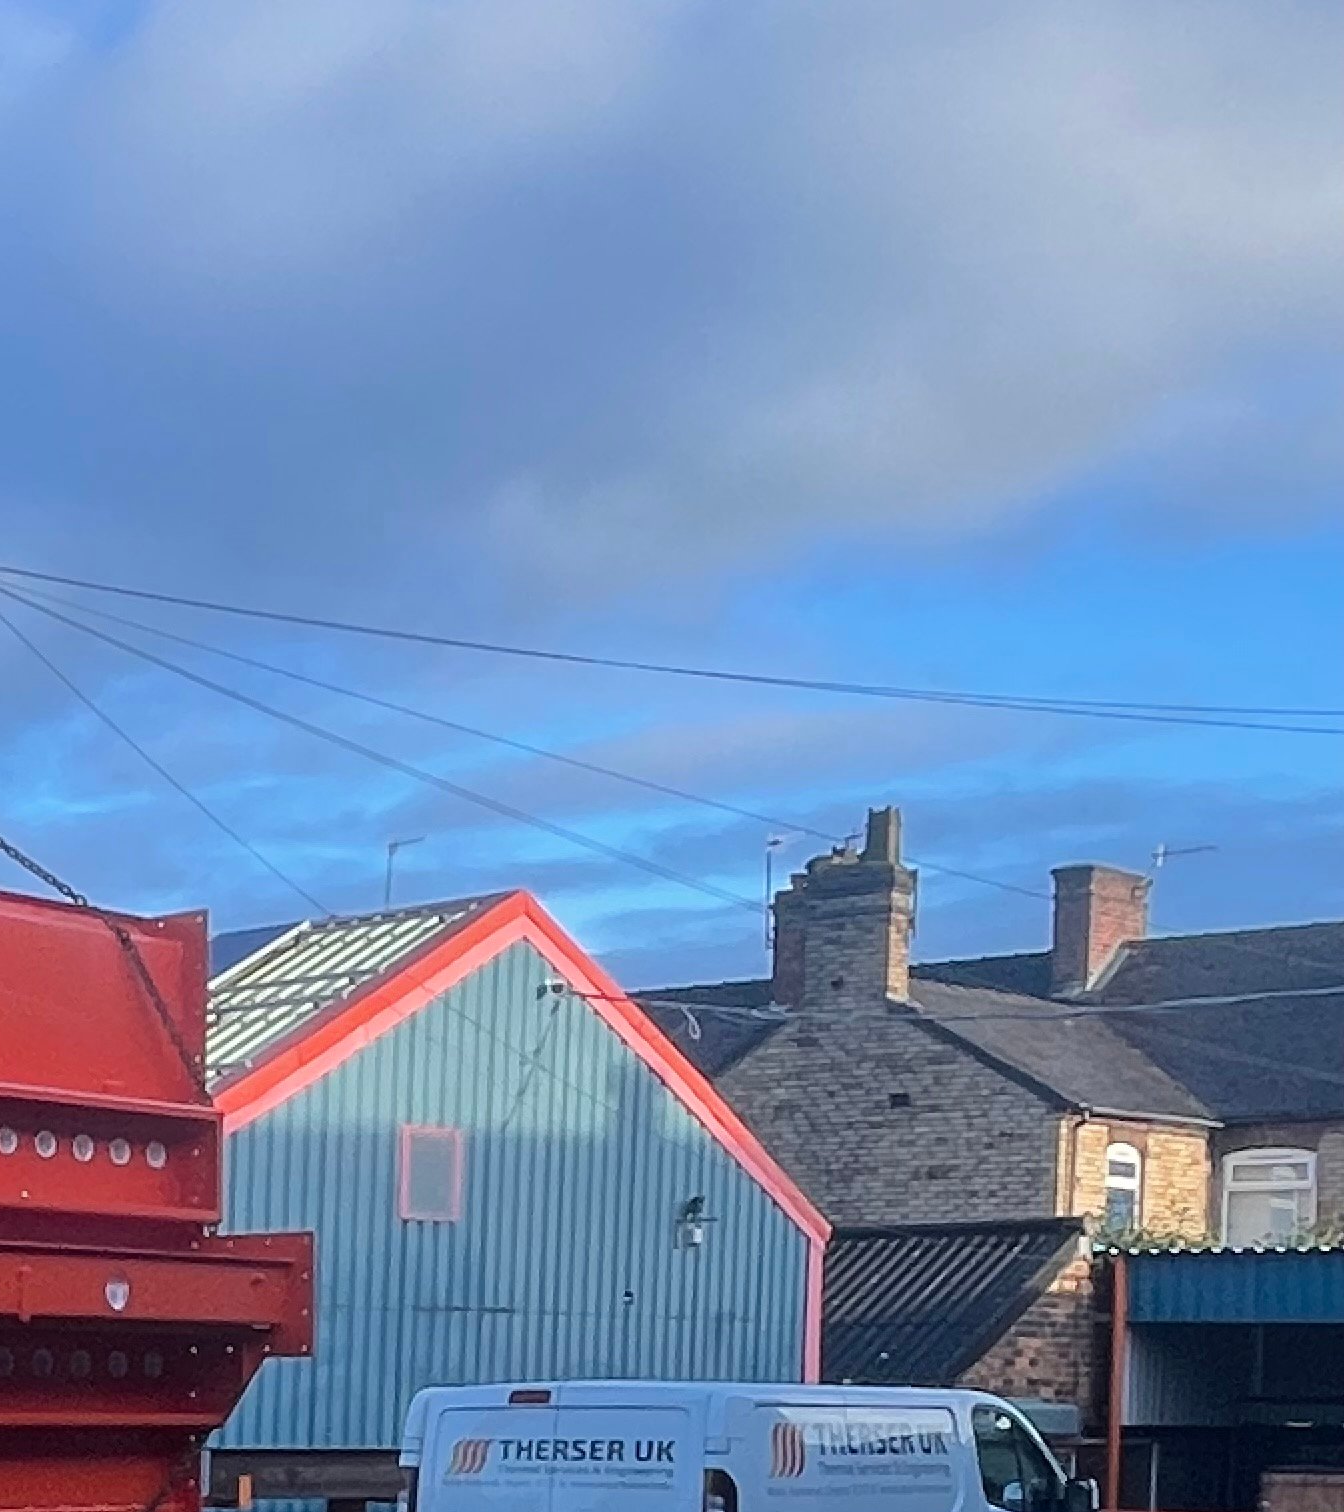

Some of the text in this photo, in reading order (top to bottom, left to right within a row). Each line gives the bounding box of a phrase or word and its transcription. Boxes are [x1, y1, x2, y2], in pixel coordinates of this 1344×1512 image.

[499, 1440, 676, 1463] THERSER UK
[814, 1422, 949, 1456] THERSER UK
